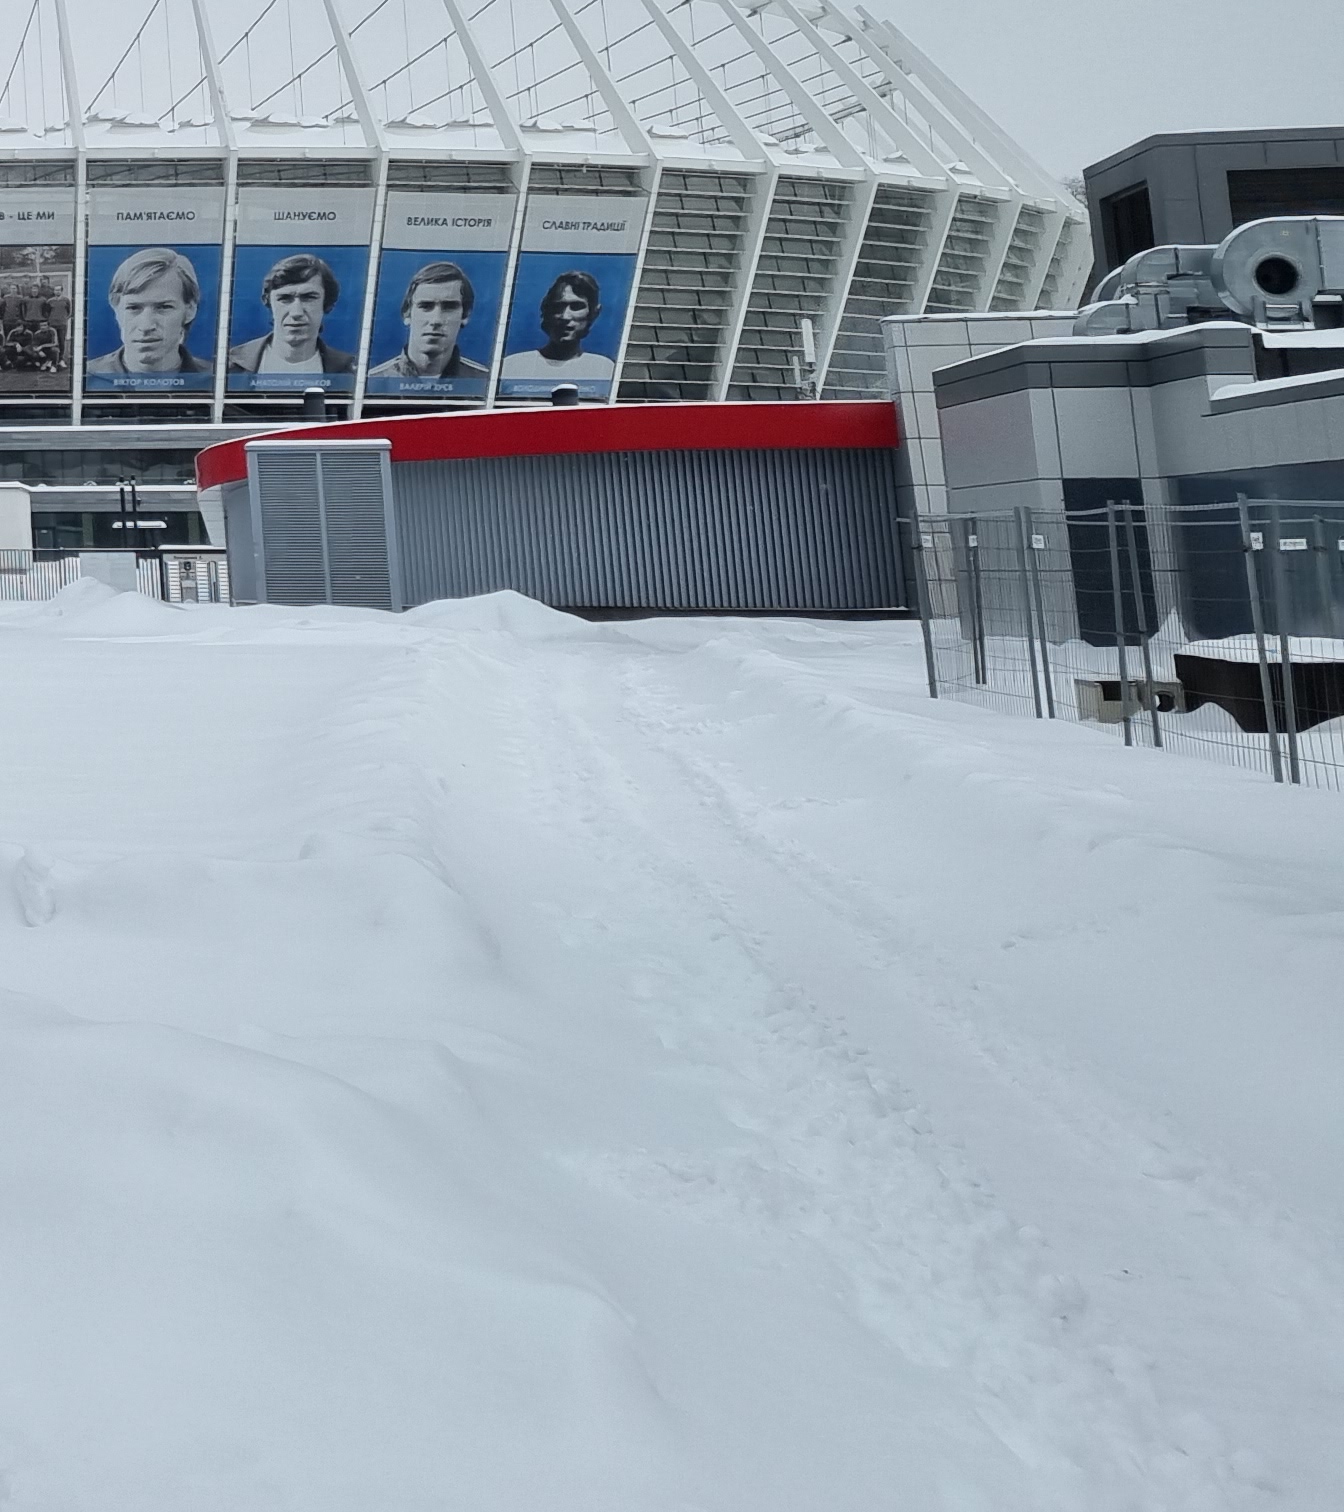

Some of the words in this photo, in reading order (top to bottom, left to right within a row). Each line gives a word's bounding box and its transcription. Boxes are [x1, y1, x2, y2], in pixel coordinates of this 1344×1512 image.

[17, 211, 33, 221] ЦЕ
[35, 211, 55, 220] МИ
[116, 211, 196, 221] ПАМ'ЯТАЄМО
[273, 211, 337, 221] ШАНУЄМО
[406, 217, 449, 227] ВЕЛИКА
[451, 217, 493, 228] ІСТОРІЯ
[542, 220, 580, 231] СЛАВНІ
[582, 219, 627, 232] ТРАДИЦІЇ
[143, 378, 185, 386] КОЛОТОВ
